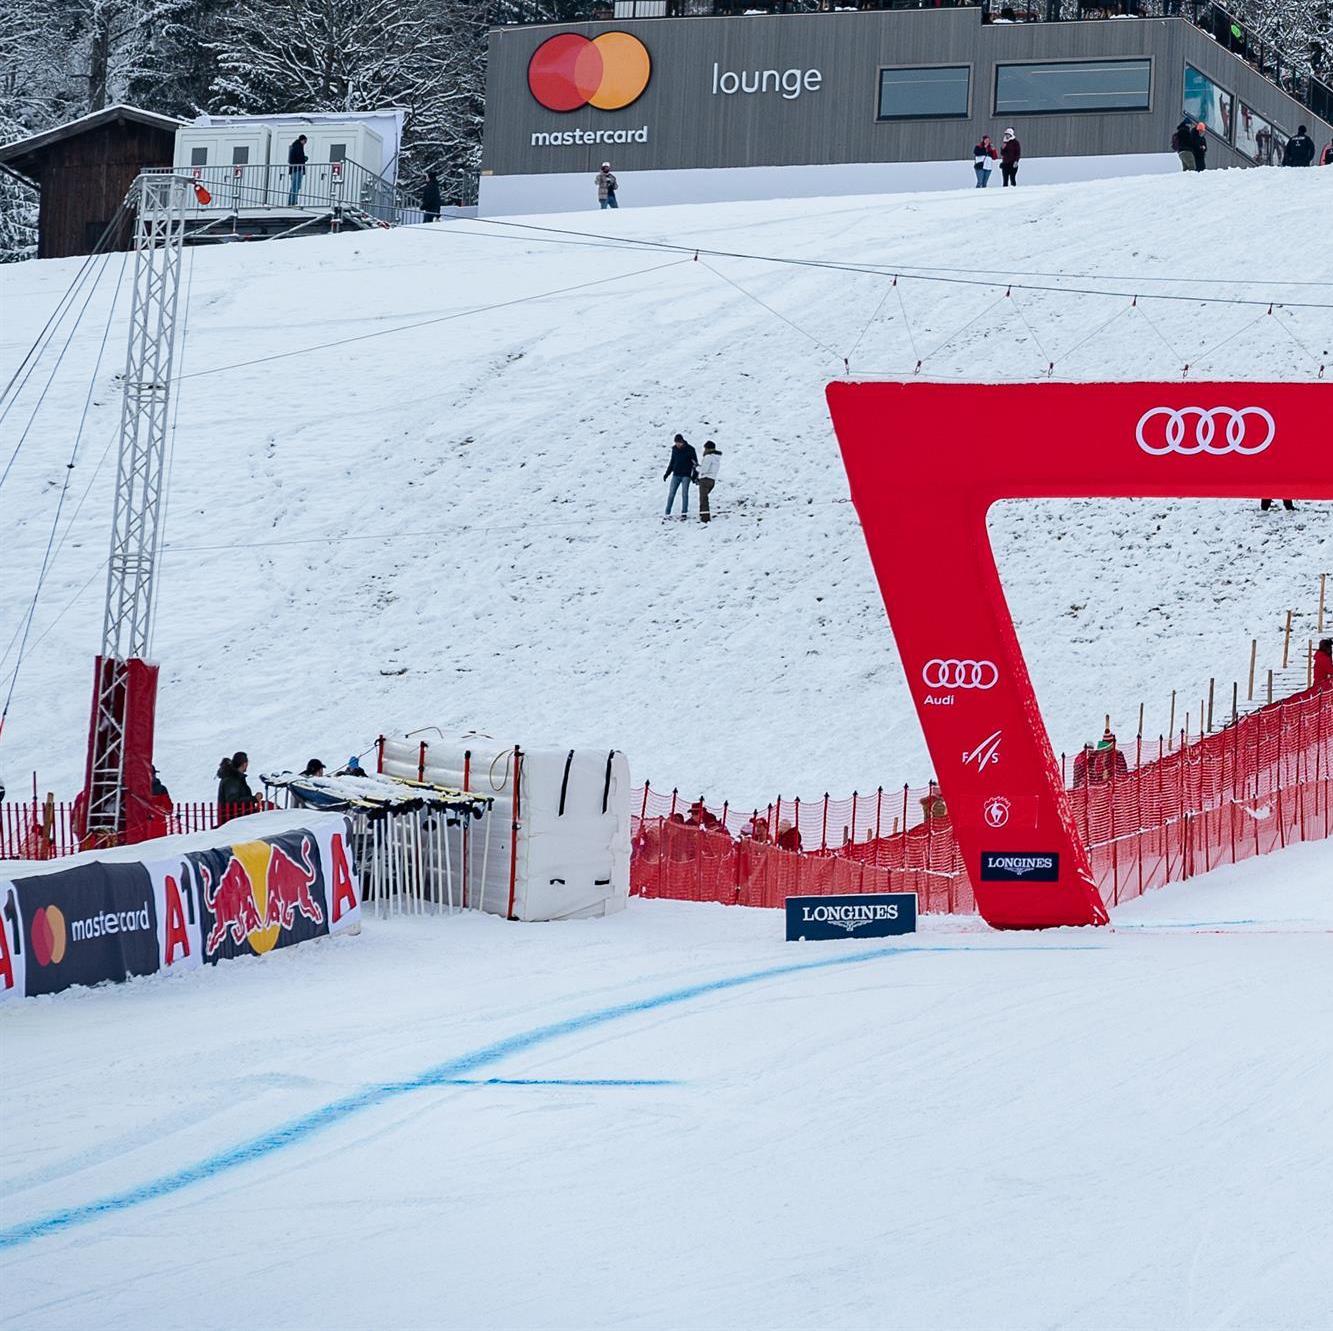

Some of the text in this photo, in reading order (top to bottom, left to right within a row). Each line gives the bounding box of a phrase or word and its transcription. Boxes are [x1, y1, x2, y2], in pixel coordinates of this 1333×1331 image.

[712, 62, 822, 100] lounge
[530, 126, 648, 146] mastercard
[923, 694, 954, 705] Audi
[987, 857, 1052, 868] LONGINES
[72, 901, 150, 942] mastercard
[164, 862, 196, 967] A1
[802, 904, 899, 921] LONGINES
